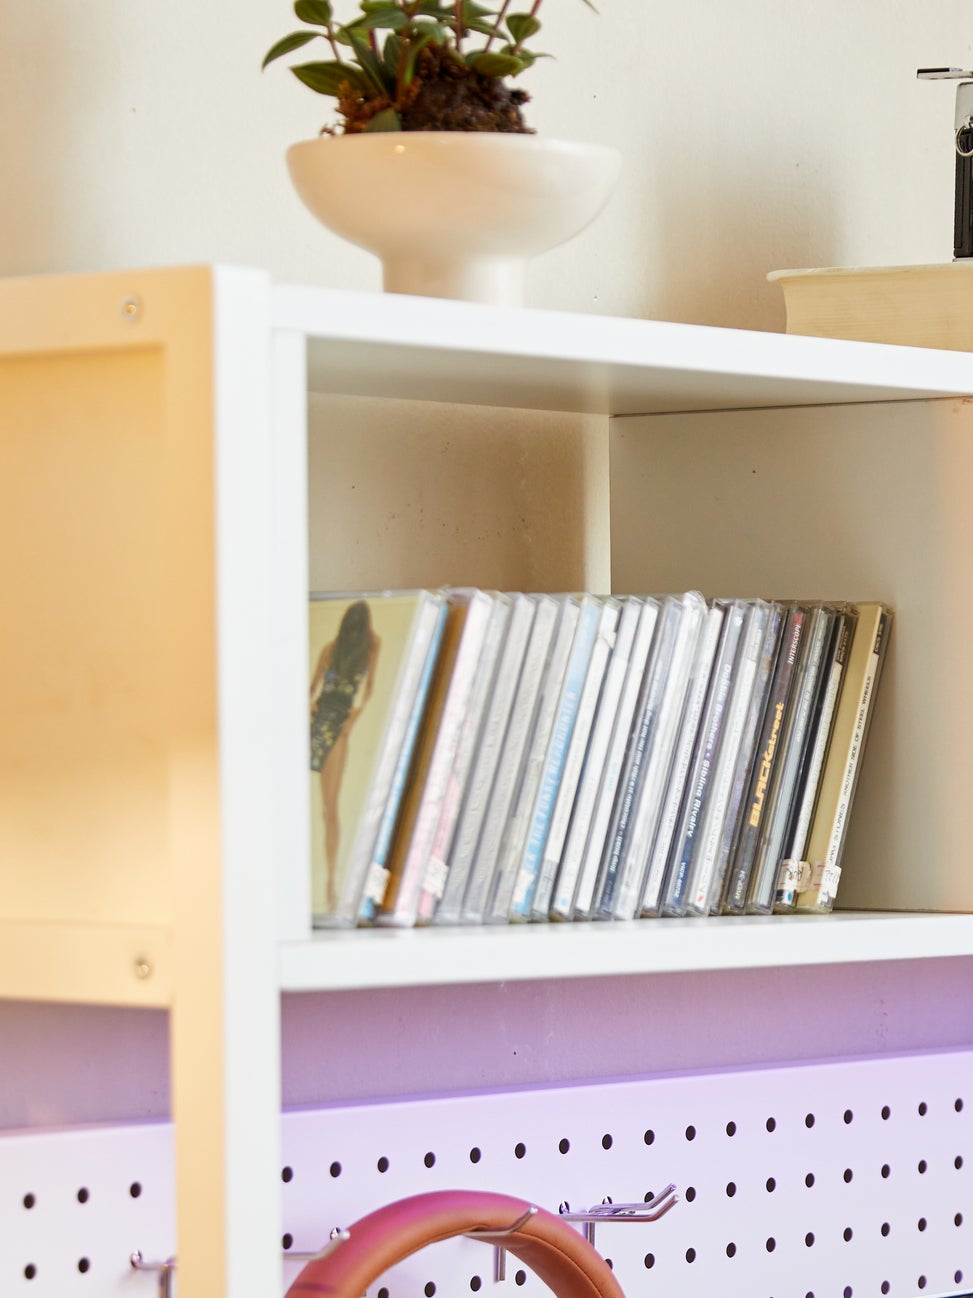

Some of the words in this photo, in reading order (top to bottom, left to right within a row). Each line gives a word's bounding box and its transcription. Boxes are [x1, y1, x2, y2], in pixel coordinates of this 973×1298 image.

[788, 624, 801, 665] INTERSCOPE
[718, 664, 732, 701] Doobie
[696, 759, 710, 800] Sibling
[687, 800, 702, 838] Rivalry
